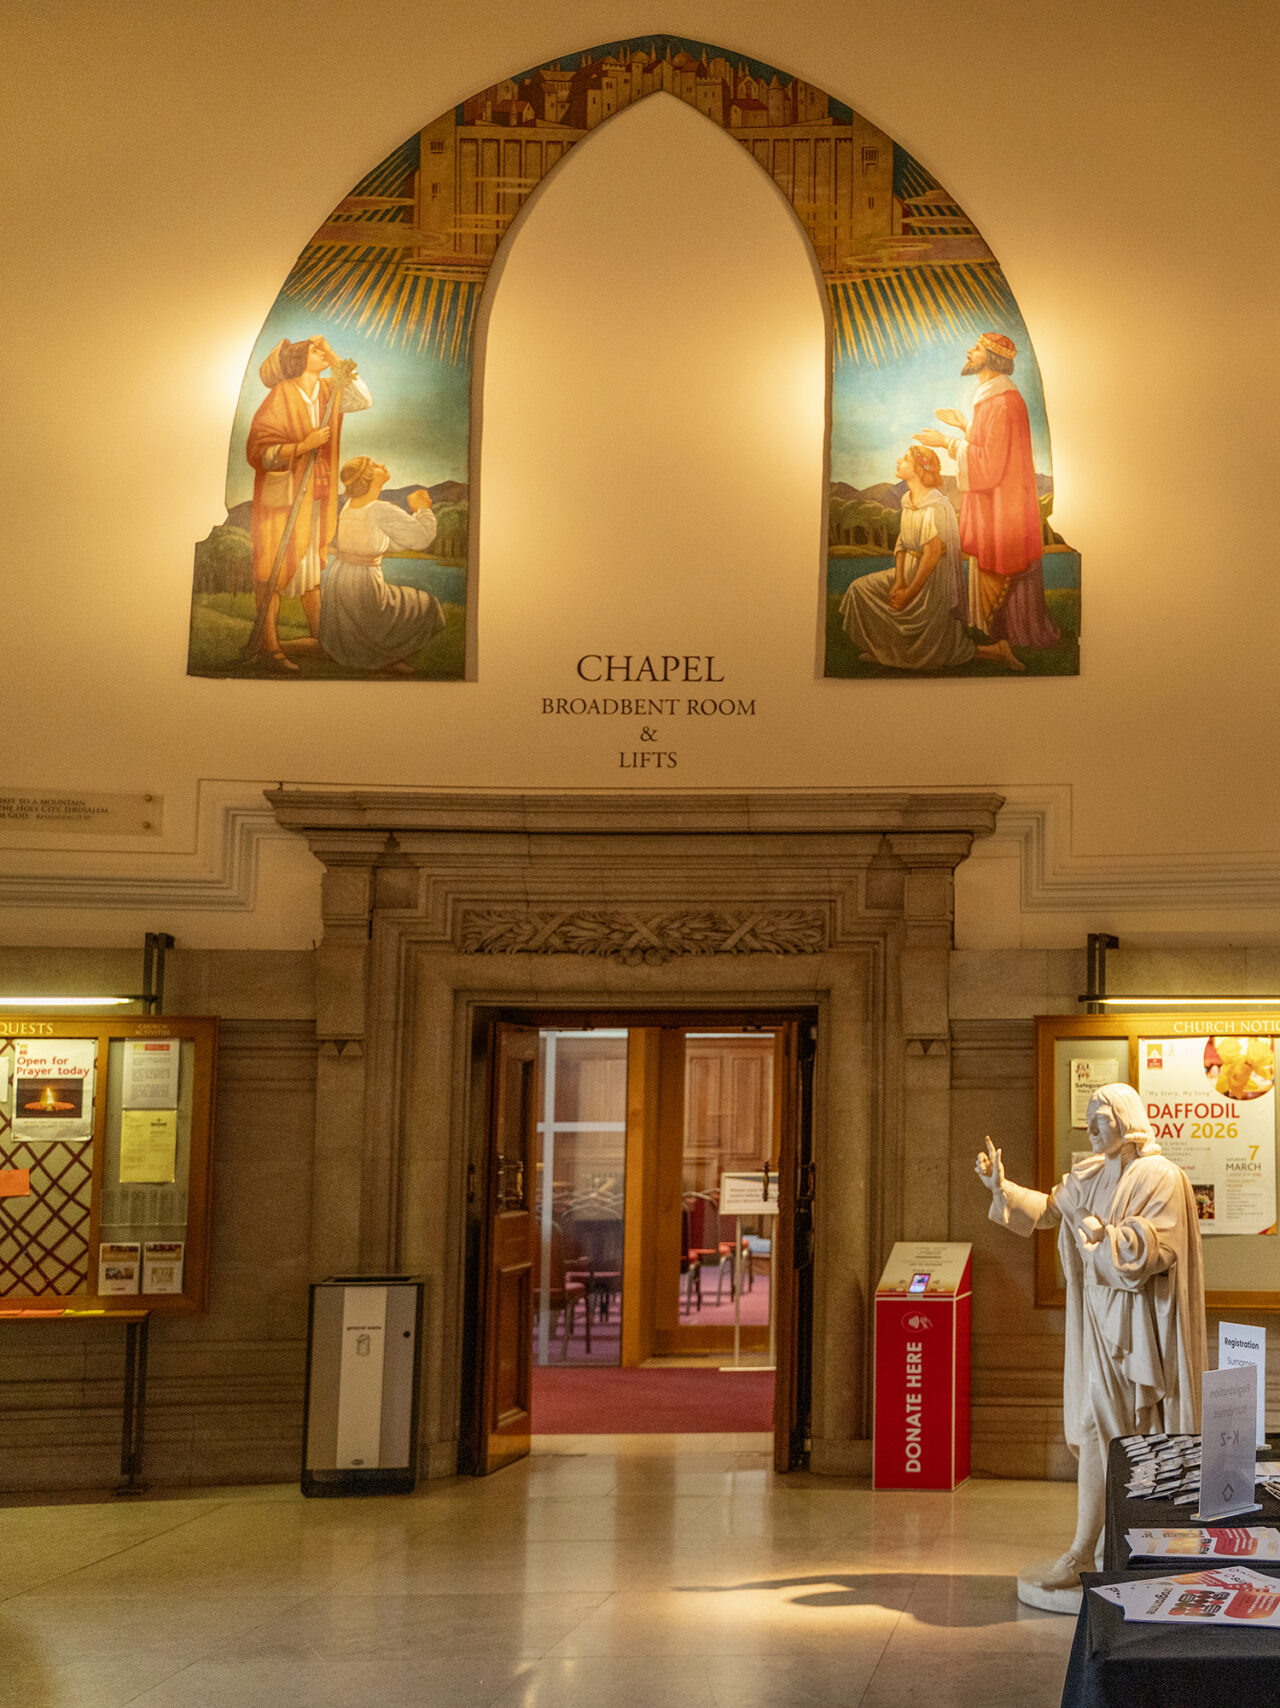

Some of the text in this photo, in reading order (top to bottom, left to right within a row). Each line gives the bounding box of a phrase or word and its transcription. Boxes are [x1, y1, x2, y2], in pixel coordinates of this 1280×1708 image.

[576, 654, 725, 683] CHAPEL
[541, 697, 756, 716] BROADBENT ROOM
[640, 725, 657, 742] &
[619, 751, 678, 769] LIFTS
[1173, 1021, 1235, 1033] CHURCH
[17, 1056, 69, 1067] Open for
[16, 1066, 90, 1078] Prayer today
[1147, 1103, 1240, 1119] DAFFODIL
[1190, 1122, 1238, 1139] 2026
[1248, 1144, 1260, 1161] 7
[1226, 1162, 1262, 1172] MARCH
[1224, 1337, 1260, 1350] Registration
[905, 1341, 922, 1473] DONATE HERE
